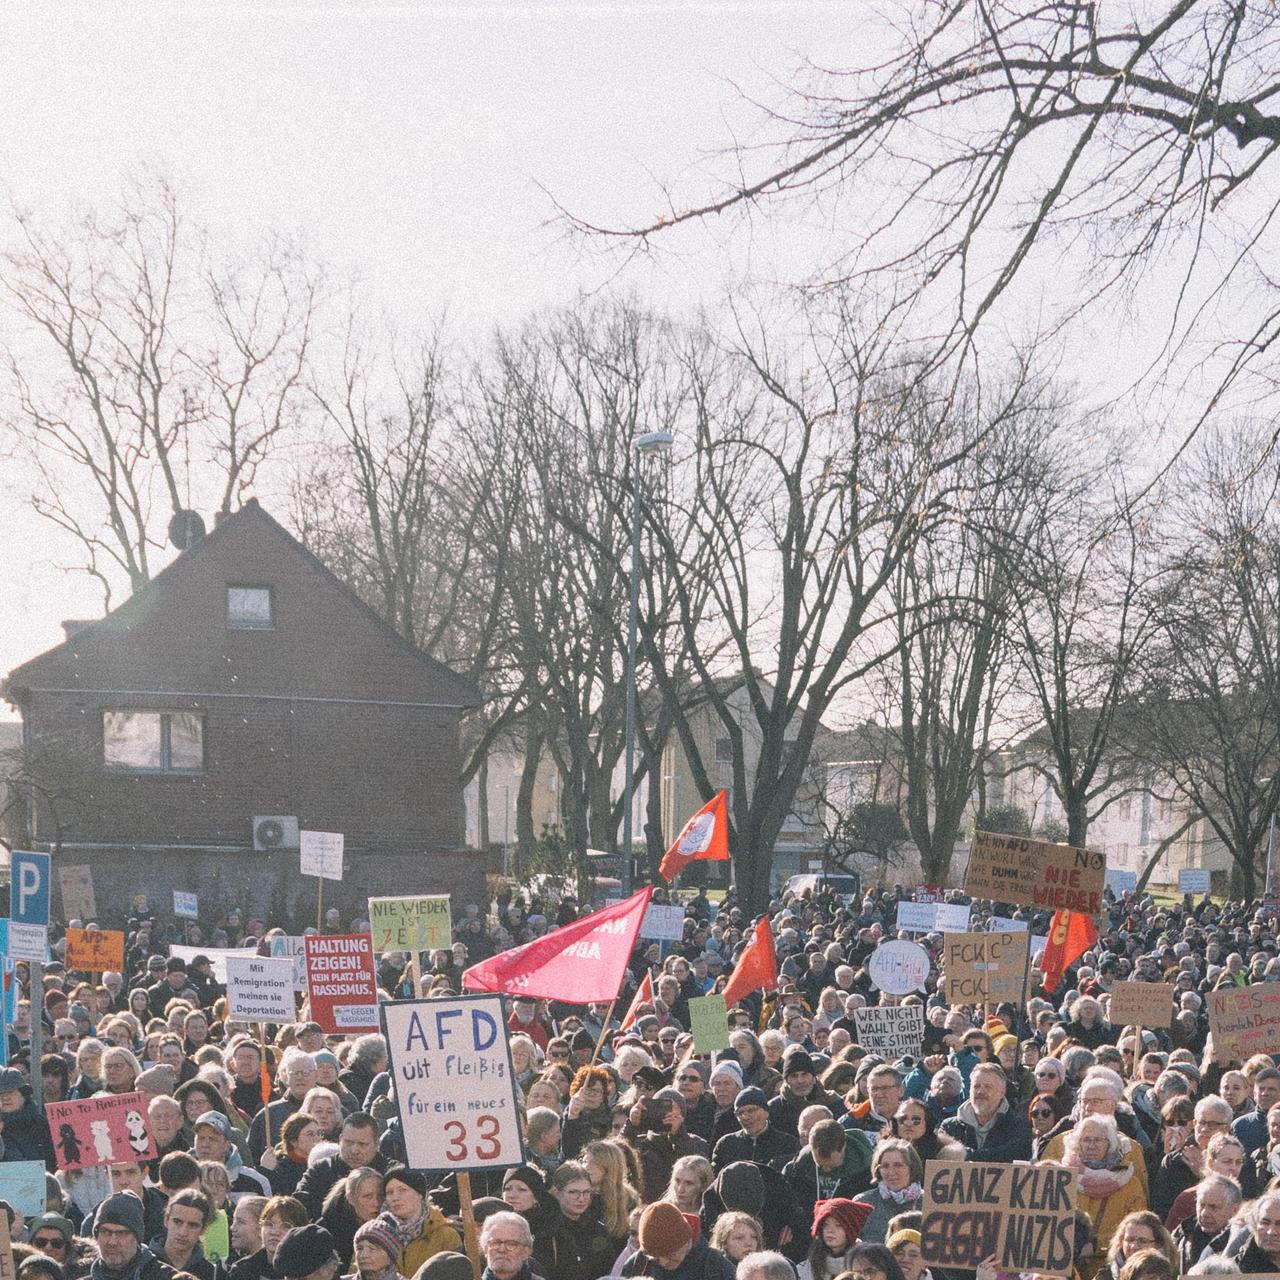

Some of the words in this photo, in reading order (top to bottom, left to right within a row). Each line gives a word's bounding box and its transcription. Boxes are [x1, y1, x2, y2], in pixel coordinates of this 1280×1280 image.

[992, 866, 1019, 878] DUMM
[1045, 865, 1082, 888] NIE
[20, 862, 40, 914] P
[373, 903, 398, 916] NIE
[401, 900, 448, 915] WIEDER
[1033, 885, 1101, 915] WIEDER
[401, 917, 420, 927] IST
[309, 939, 368, 953] HALTUNG
[951, 944, 984, 966] FCK
[249, 964, 264, 973] Mit
[311, 957, 361, 970] ZEIGEN!
[312, 973, 329, 982] KEIN
[332, 973, 353, 982] PLATZ
[356, 971, 371, 981] FÜR
[313, 984, 373, 996] RASSISMUS.
[951, 978, 985, 997] FCK
[239, 992, 269, 1001] meinen
[270, 993, 282, 1001] sie
[857, 1010, 882, 1021] WER
[886, 1006, 920, 1020] NICHT
[405, 1009, 497, 1051] AFD
[898, 1019, 922, 1032] GIBT
[861, 1036, 886, 1047] SEINE
[888, 1032, 923, 1046] STIMME
[403, 1058, 430, 1080] übt
[408, 1092, 430, 1115] für
[434, 1101, 456, 1112] ein
[468, 1098, 506, 1110] neues
[444, 1115, 502, 1162] 33
[931, 1167, 1004, 1204] GANZ
[1009, 1167, 1072, 1211] KLAR
[920, 1210, 1003, 1266] GEGEN
[1002, 1214, 1074, 1271] NAZIS
